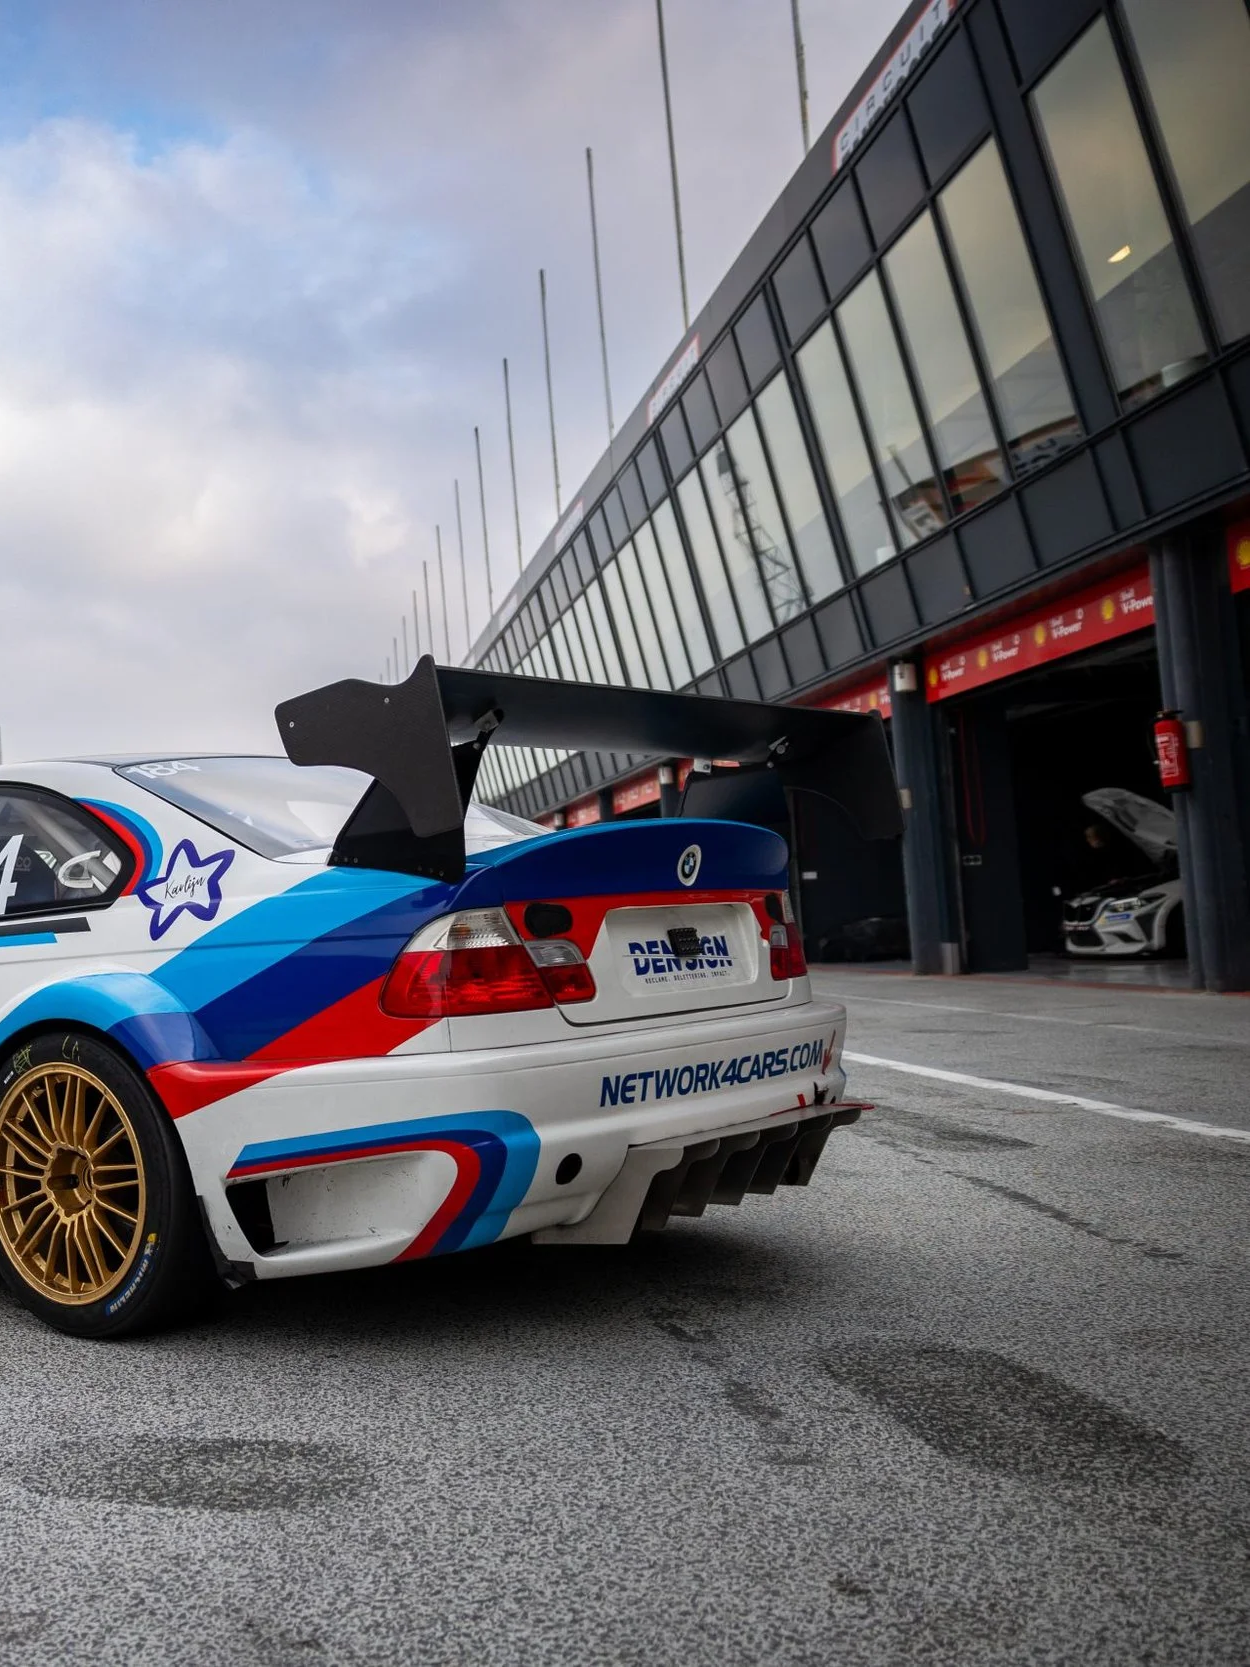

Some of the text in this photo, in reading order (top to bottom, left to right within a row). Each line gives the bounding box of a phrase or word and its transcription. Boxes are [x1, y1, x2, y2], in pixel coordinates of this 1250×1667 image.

[1121, 595, 1154, 614] V-Powe
[126, 761, 201, 779] 184
[600, 1038, 823, 1108] NETWORK4CARS.COM
